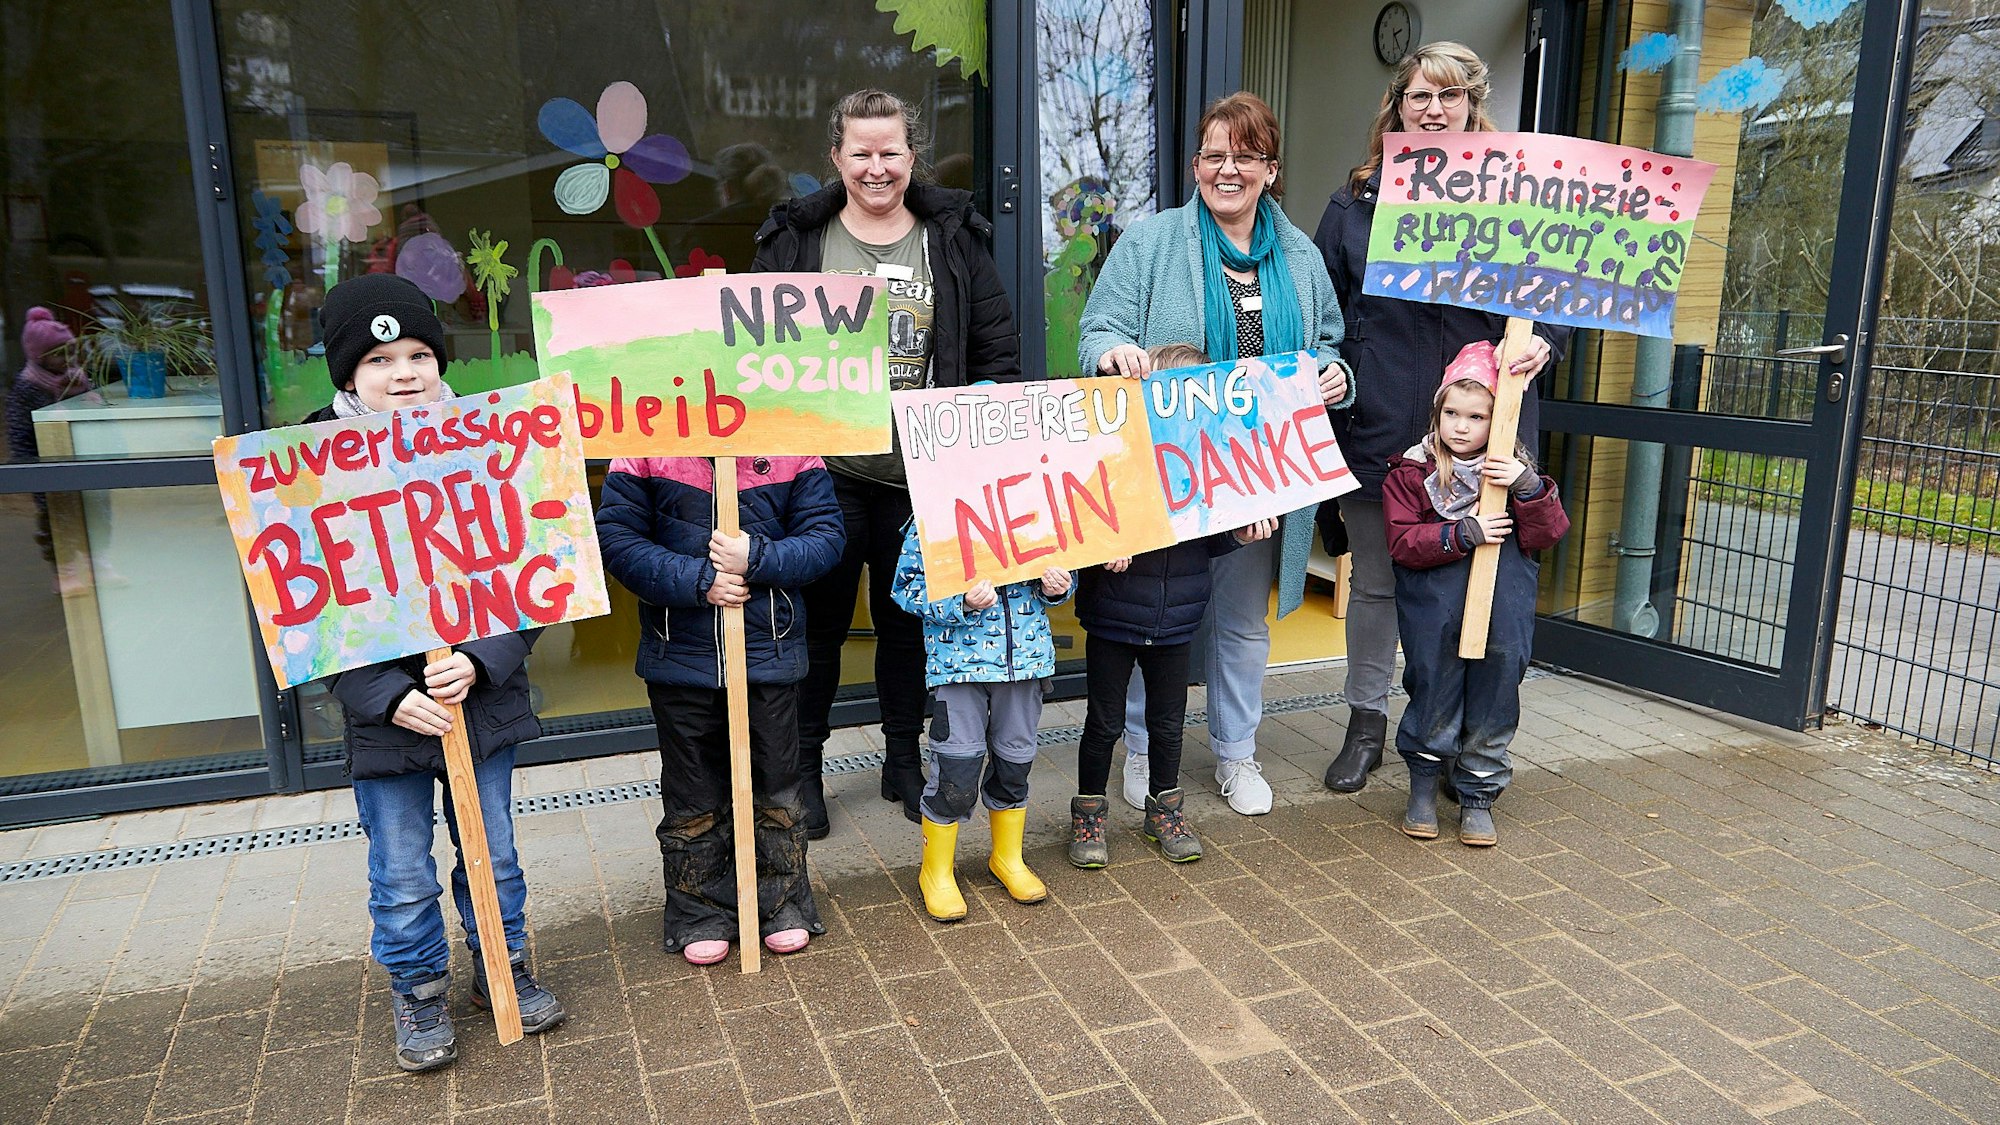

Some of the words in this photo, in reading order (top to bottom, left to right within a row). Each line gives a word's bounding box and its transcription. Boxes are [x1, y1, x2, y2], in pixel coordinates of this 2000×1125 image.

[1519, 218, 1594, 259] von
[720, 283, 875, 346] NRW
[737, 341, 883, 394] sozial
[889, 364, 912, 378] OLL
[573, 369, 746, 439] bleib
[239, 392, 562, 493] zuverlässige
[1155, 404, 1349, 513] DANKE
[247, 470, 568, 627] BETREU-
[429, 554, 576, 645] UNG
